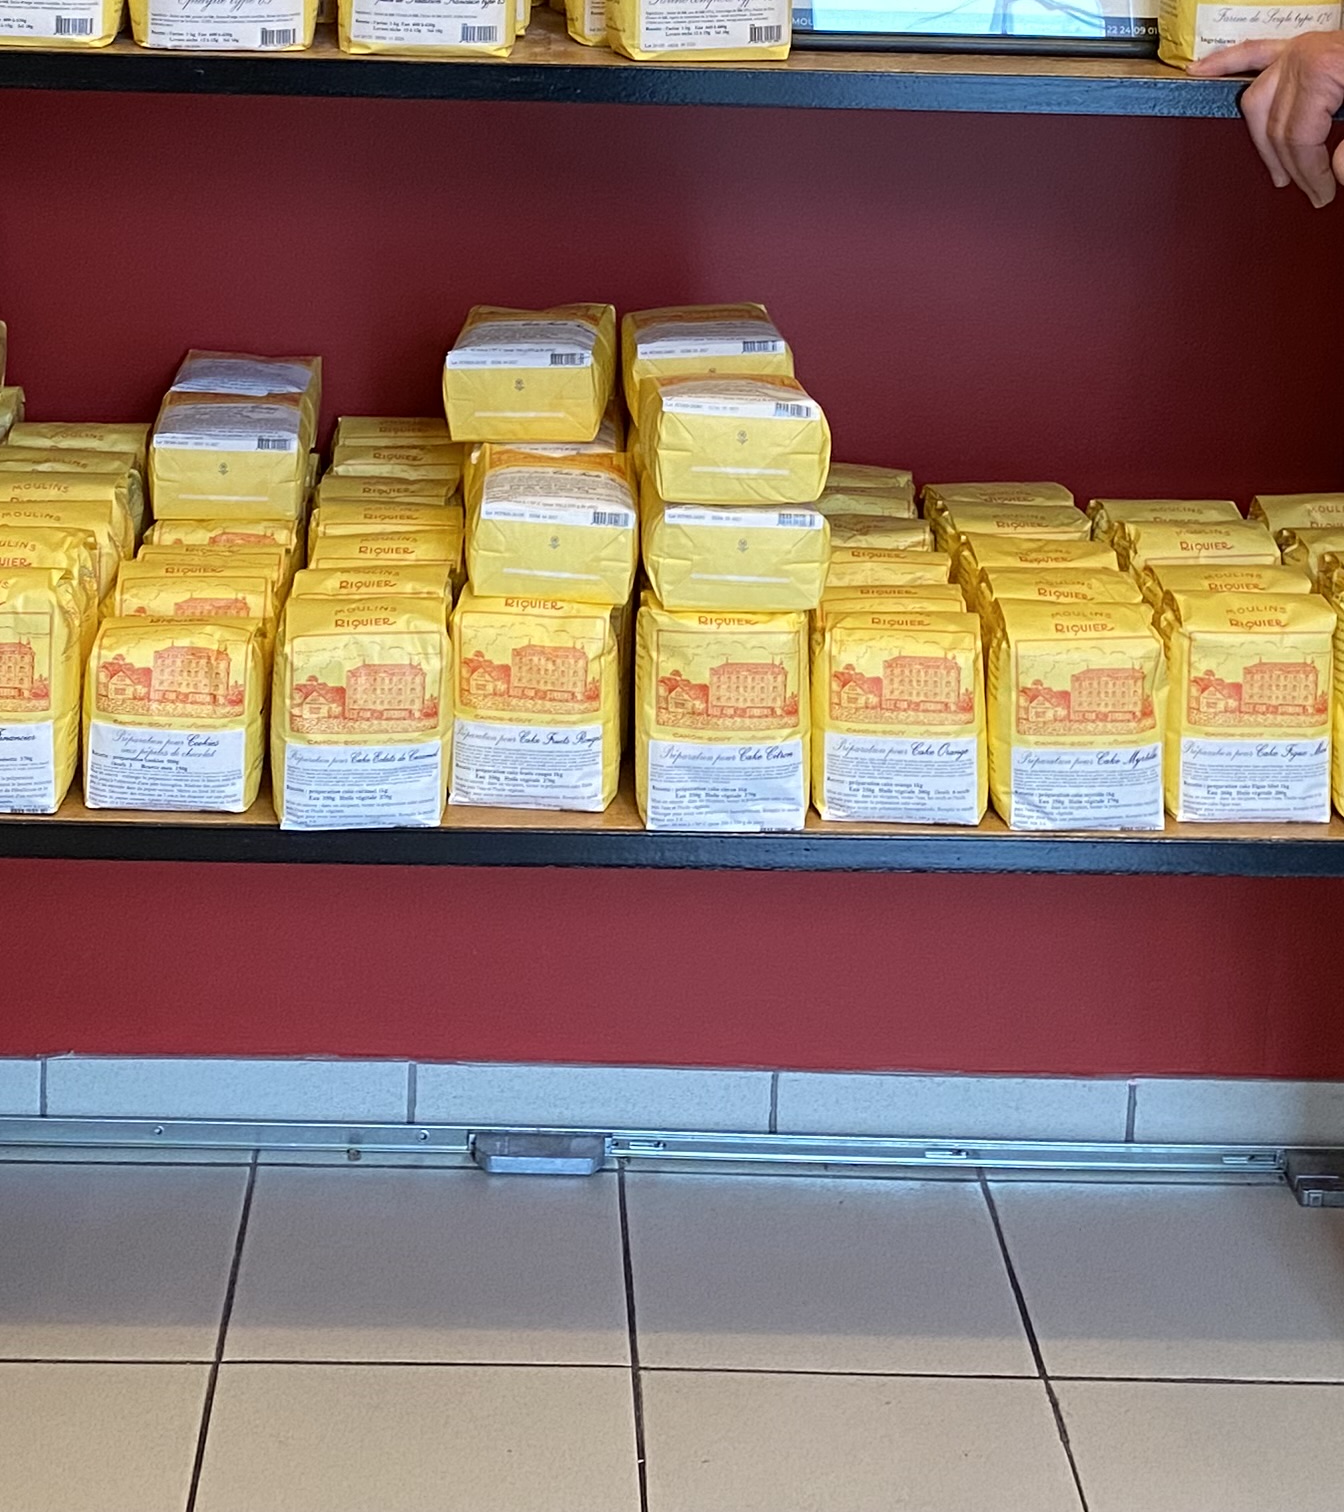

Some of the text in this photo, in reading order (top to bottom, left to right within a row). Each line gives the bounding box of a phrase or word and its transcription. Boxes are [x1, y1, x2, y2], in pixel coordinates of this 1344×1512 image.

[1107, 26, 1119, 35] 22
[1134, 27, 1145, 36] 09
[359, 545, 416, 558] RIQUIER
[339, 578, 397, 592] RIQUIER
[1037, 587, 1095, 602] RIQUIER
[334, 605, 397, 616] MOULINS
[504, 598, 565, 612] RIQUIER
[1225, 605, 1287, 616] MOULINS
[1051, 610, 1112, 620] MOULINS
[334, 617, 396, 631] RIQUIER
[698, 615, 759, 630] RIQUIER
[871, 617, 931, 628] RIQUIER
[1054, 623, 1115, 636] RIQUIER
[1229, 618, 1290, 631] RIQUIER
[738, 746, 794, 761] Cake Citron
[911, 741, 969, 762] Cake Orange
[1255, 743, 1279, 757] Cake
[1096, 750, 1121, 766] Cake
